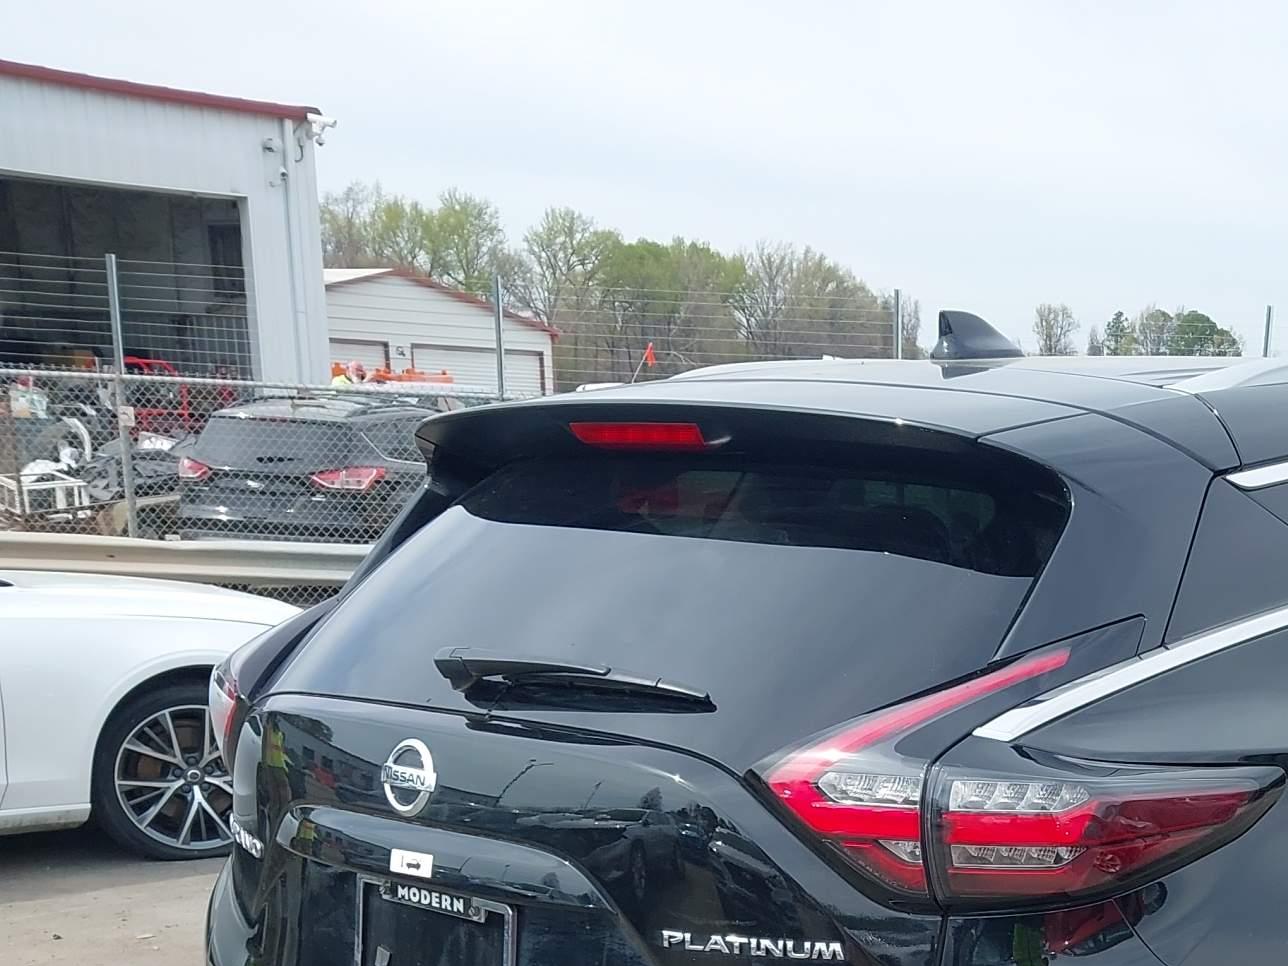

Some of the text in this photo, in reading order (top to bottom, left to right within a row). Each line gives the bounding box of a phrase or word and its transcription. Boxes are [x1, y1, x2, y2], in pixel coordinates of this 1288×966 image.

[384, 765, 426, 787] NISSAN
[397, 885, 464, 914] MODERN
[661, 930, 845, 961] PLATINUM
